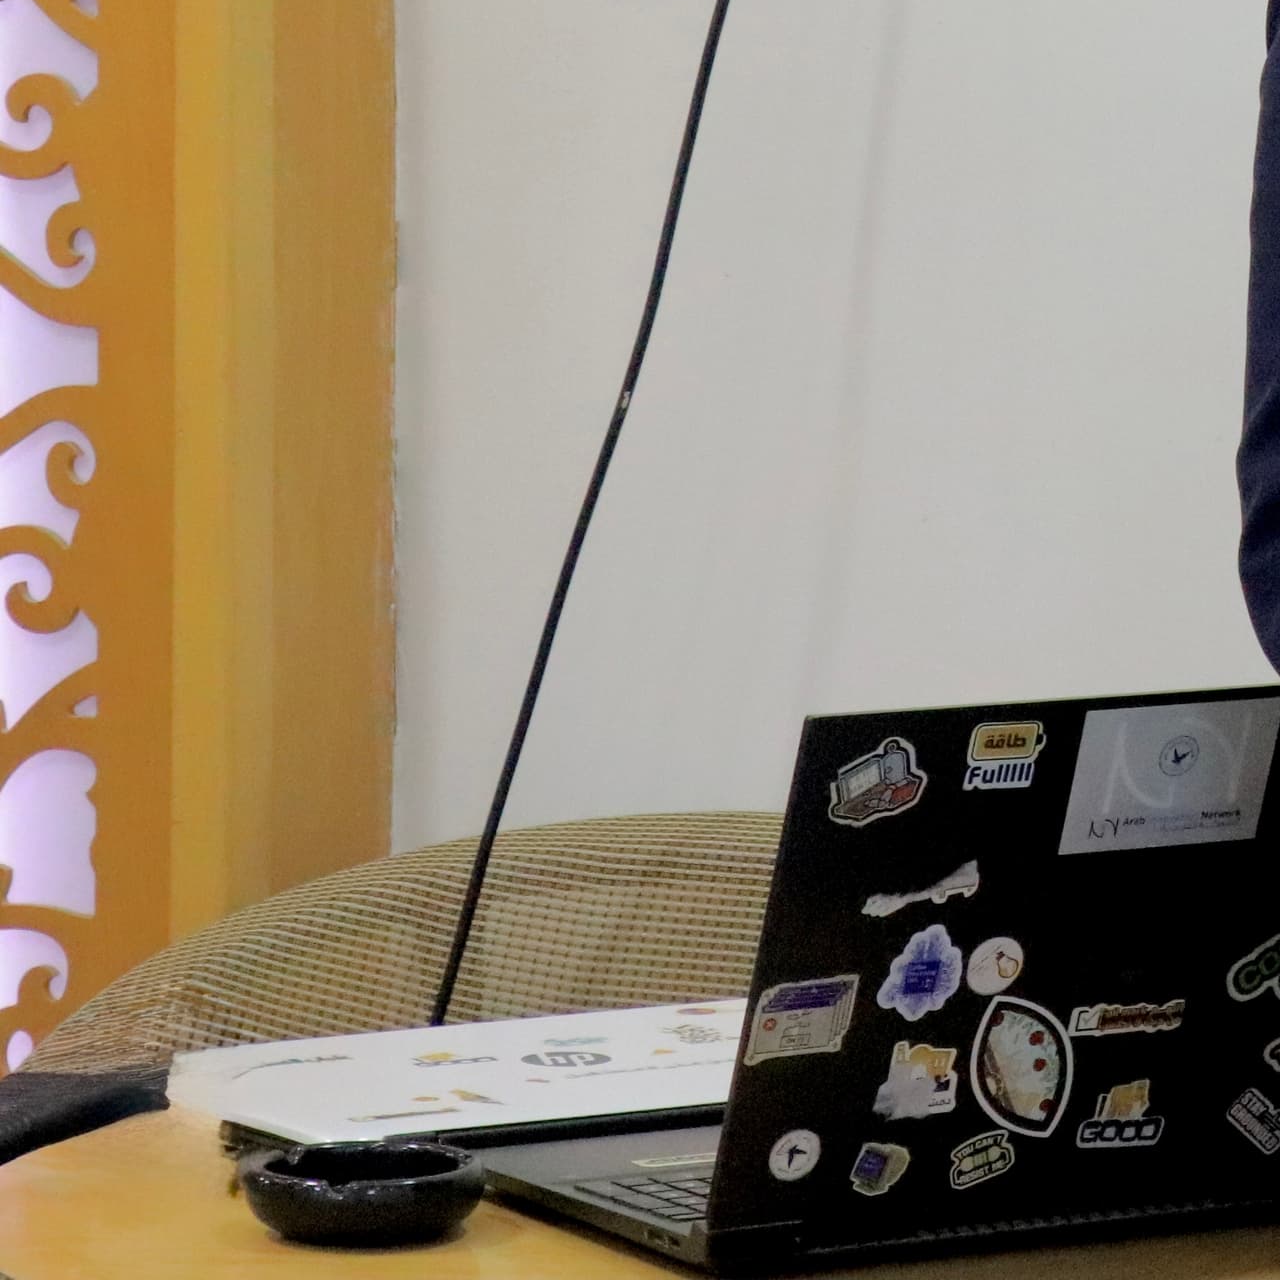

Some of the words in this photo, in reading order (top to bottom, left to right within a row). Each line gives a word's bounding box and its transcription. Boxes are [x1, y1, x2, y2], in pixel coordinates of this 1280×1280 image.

[983, 732, 1027, 749] طاقة
[1240, 1091, 1268, 1117] STAY
[1080, 1120, 1162, 1143] GOOD
[955, 1143, 975, 1159] YOU
